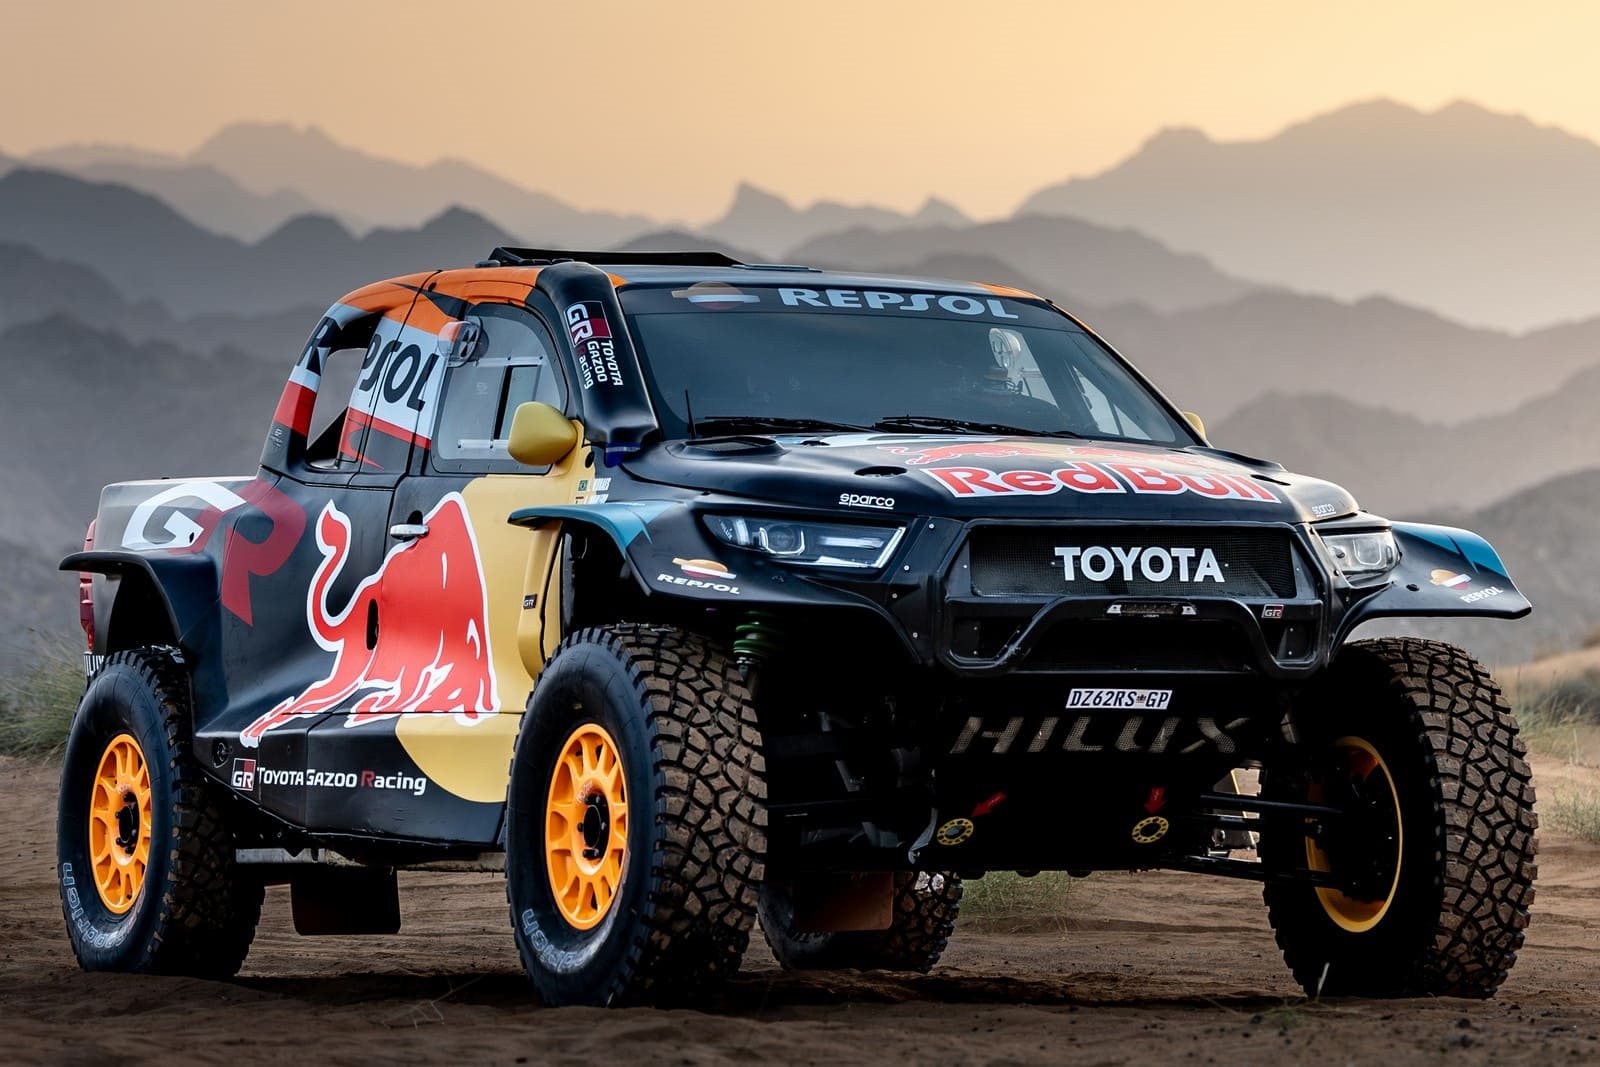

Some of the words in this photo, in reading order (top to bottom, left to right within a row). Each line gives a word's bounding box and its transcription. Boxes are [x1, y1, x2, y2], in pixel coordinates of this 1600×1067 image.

[777, 287, 1020, 320] REPSOL
[566, 303, 593, 345] GR
[574, 345, 594, 390] Racing
[586, 340, 608, 382] GAZOO
[600, 339, 624, 386] TOYOTA
[921, 460, 1128, 499] Red
[1104, 462, 1282, 504] Bull
[838, 492, 896, 510] sparco
[1053, 545, 1228, 583] TOYOTA
[656, 573, 741, 595] REPSOL
[1459, 586, 1504, 604] REPSOL
[1263, 608, 1284, 618] GR
[1069, 690, 1136, 707] DZ62RS
[1145, 692, 1170, 709] GP
[948, 716, 1251, 754] HILUX
[232, 770, 253, 789] GR
[257, 766, 304, 786] TOYOTA
[306, 768, 358, 788] GAZOO
[360, 770, 428, 796] Racing
